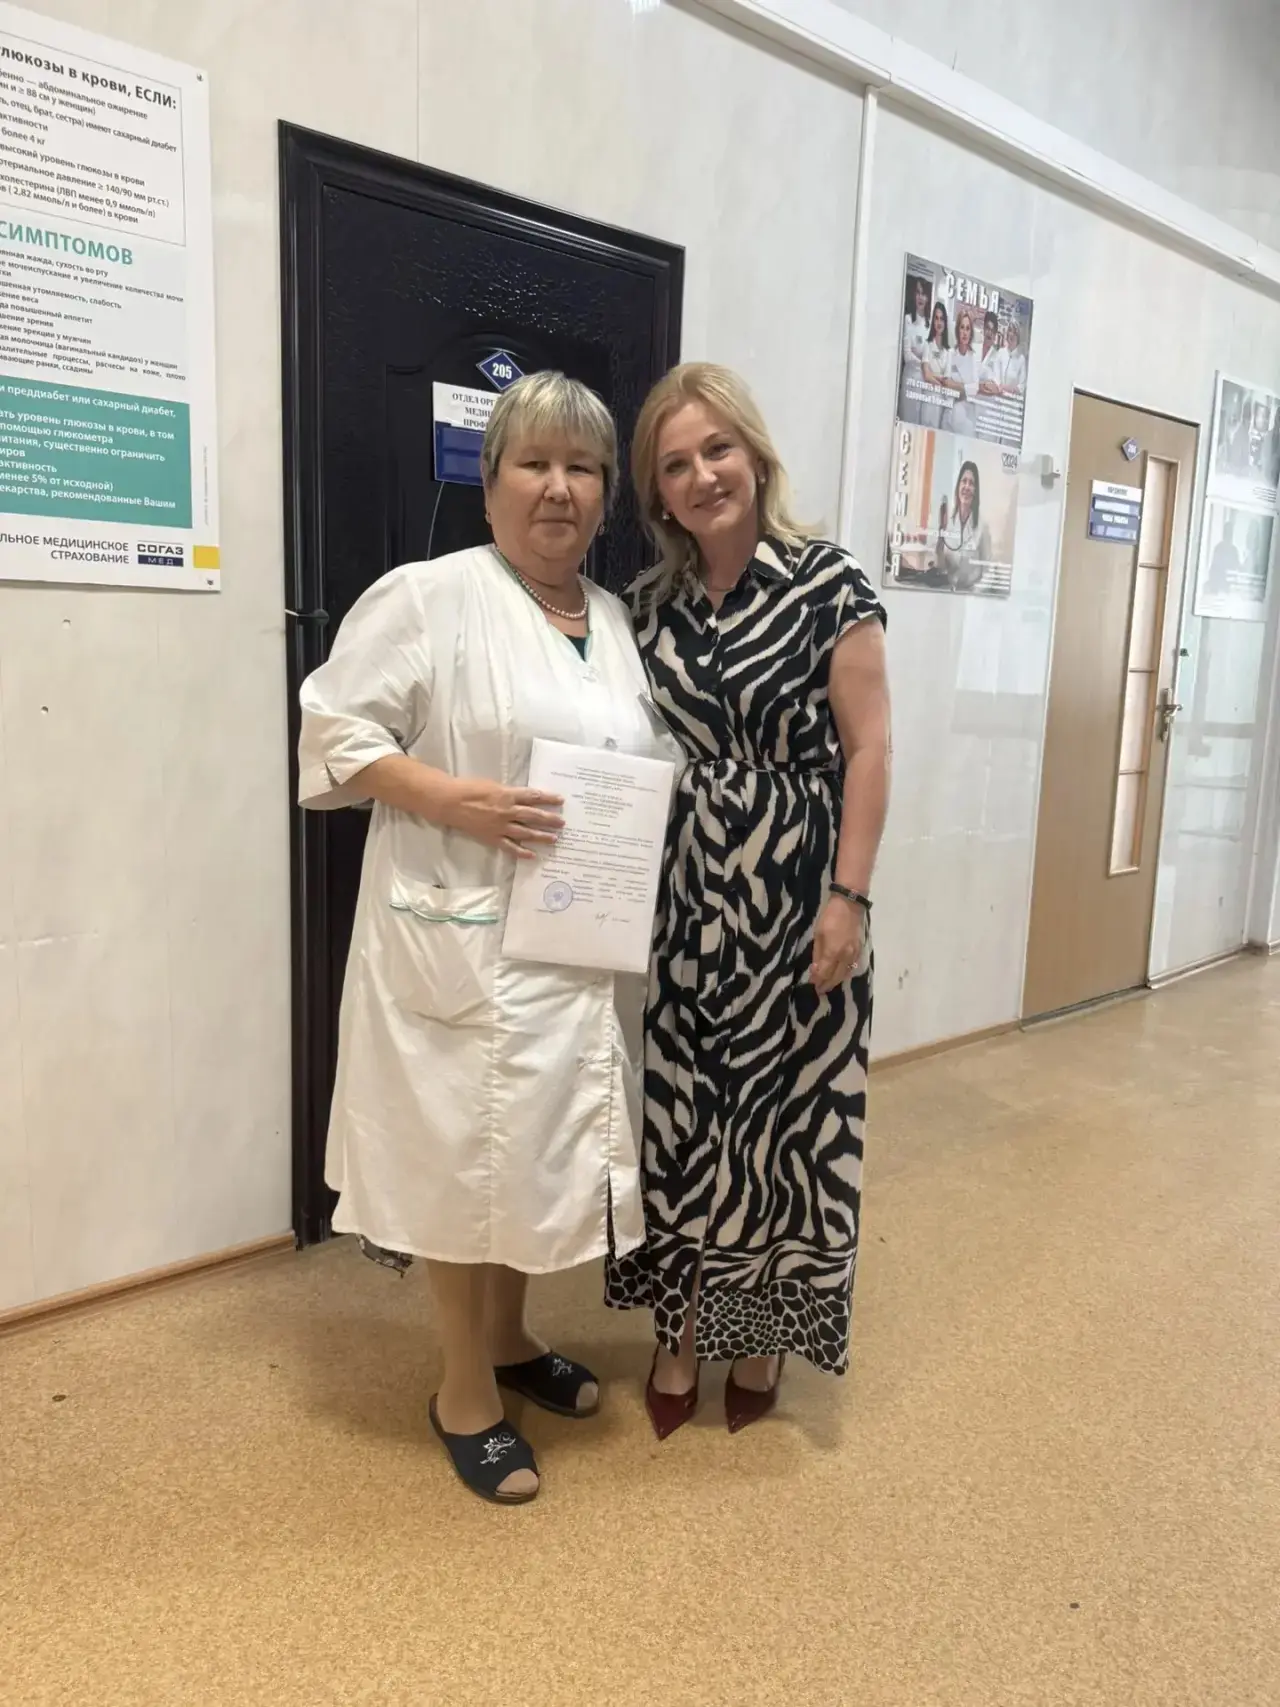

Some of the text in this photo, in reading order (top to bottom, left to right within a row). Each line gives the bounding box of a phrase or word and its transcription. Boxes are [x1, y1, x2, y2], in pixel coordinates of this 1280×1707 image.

[0, 46, 176, 109] люкозы в крови, ЕСЛИ:
[27, 88, 37, 98] 88
[39, 93, 50, 101] см
[52, 96, 57, 105] у
[58, 98, 96, 116] женщин)
[38, 81, 105, 106] абдоминальное
[107, 102, 148, 119] ожирение
[1, 127, 28, 141] более
[29, 135, 35, 143] 4
[33, 105, 54, 119] брат,
[56, 113, 85, 127] сестра)
[86, 121, 111, 134] имеют
[113, 129, 150, 145] сахарный
[151, 140, 177, 153] диабет
[0, 144, 38, 159] высокий
[40, 153, 75, 169] уровень
[77, 163, 113, 178] глюкозы
[121, 175, 145, 186] крови
[56, 173, 96, 188] давление
[106, 184, 132, 197] 140/90
[134, 192, 146, 201] мм
[33, 192, 70, 209] ммоль/л
[79, 202, 106, 216] более)
[114, 213, 139, 223] крови
[56, 186, 77, 198] (ЛВП
[78, 193, 104, 205] менее
[105, 199, 118, 208] 0,9
[119, 203, 156, 218] ммоль/л)
[0, 220, 133, 265] СИМПТОМОВ
[26, 254, 54, 266] жажда,
[55, 260, 84, 272] сухость
[96, 269, 108, 278] рту
[8, 262, 72, 280] мочеиспускание
[80, 276, 123, 290] увеличение
[125, 285, 165, 299] количества
[166, 294, 184, 303] мочи
[946, 273, 1000, 314] СЕМЬЯ
[0, 281, 122, 309] шенная утомляемость, слабость
[22, 295, 39, 304] веса
[11, 304, 62, 319] повышенный
[63, 313, 93, 324] аппетит
[26, 318, 54, 328] зрения
[11, 337, 54, 349] молочница
[55, 343, 106, 358] (вагинальный
[62, 335, 92, 345] мужчин
[53, 353, 91, 366] процессы,
[62, 364, 94, 375] ссадины
[492, 362, 512, 380] 205
[7, 386, 70, 401] преддиабет
[72, 395, 91, 405] или
[92, 398, 140, 412] сахарный
[141, 405, 176, 418] диабет,
[452, 392, 480, 404] ОТДЕЛ
[0, 422, 114, 445] помощью глюкометра
[17, 412, 61, 426] уровень
[63, 418, 106, 431] глюкозы
[108, 424, 114, 432] в
[116, 425, 148, 438] крови,
[149, 430, 156, 438] в
[157, 431, 175, 440] том
[43, 440, 109, 454] существенно
[110, 448, 165, 462] ограничить
[32, 474, 47, 484] 5%
[49, 477, 61, 485] от
[63, 478, 114, 492] исходной)
[51, 489, 142, 505] рекомендованные
[143, 496, 176, 509] Вашим
[891, 430, 911, 577] СЕМЬЯ
[43, 536, 129, 552] МЕДИЦИНСКОЕ
[137, 543, 184, 556] СОГАЗ
[50, 550, 130, 564] СТРАХОВАНИЕ
[147, 557, 174, 566] МЕД
